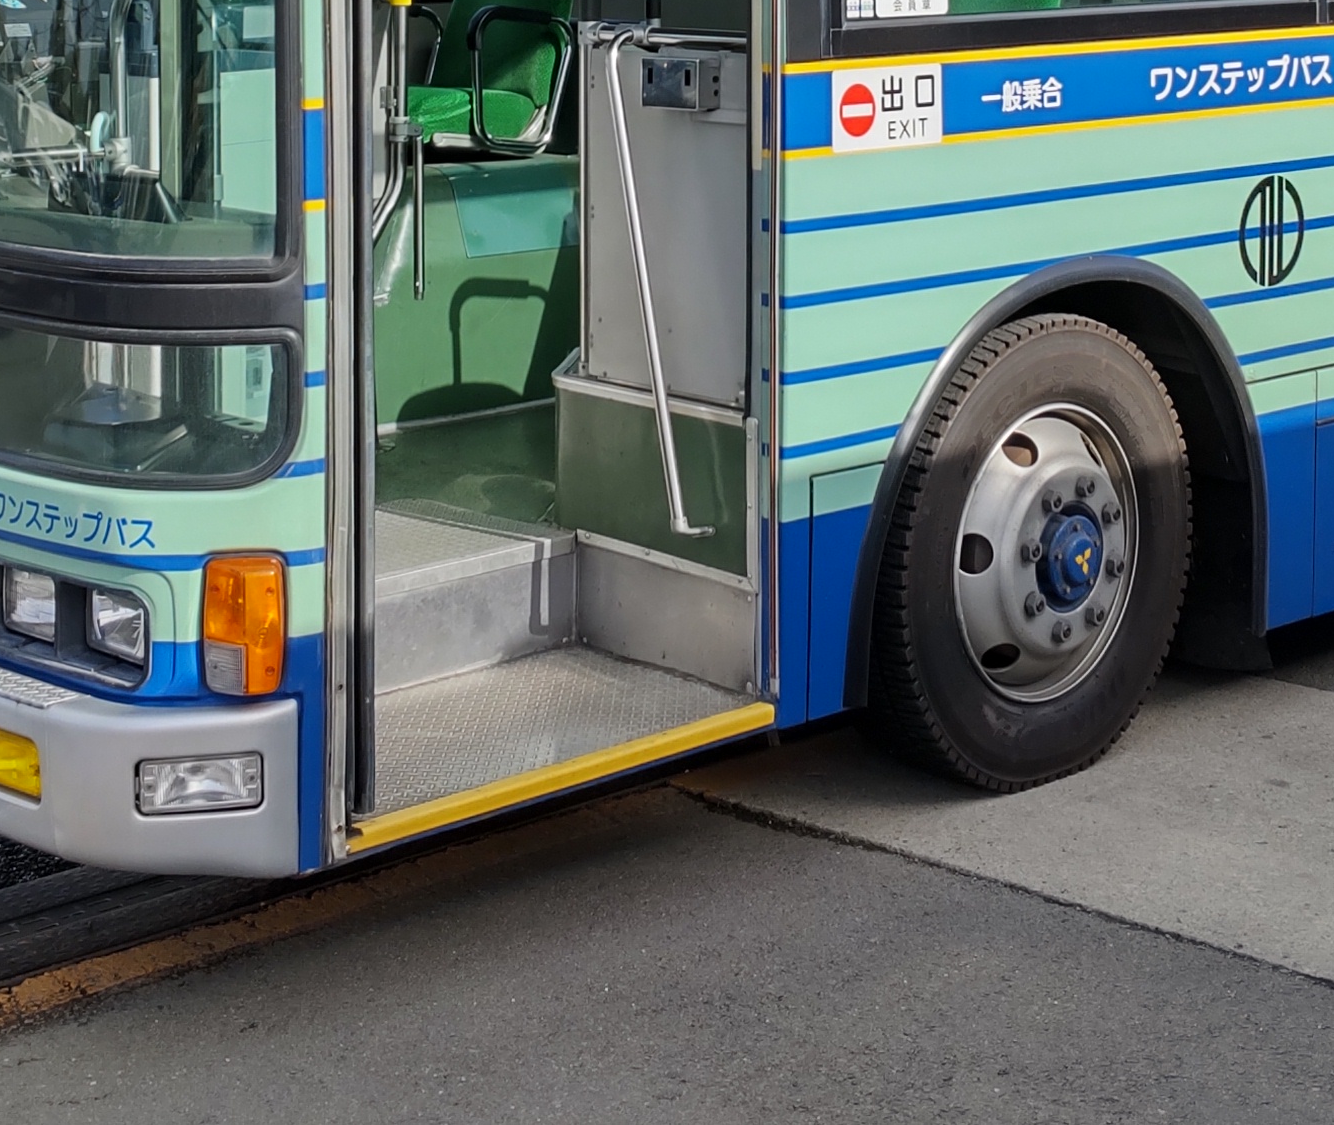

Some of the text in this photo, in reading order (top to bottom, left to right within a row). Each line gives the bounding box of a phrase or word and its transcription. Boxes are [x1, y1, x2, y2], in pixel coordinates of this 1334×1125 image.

[881, 74, 935, 112] 出口
[980, 76, 1064, 113] 一般乗合
[1149, 53, 1333, 102] ワンステップバス
[888, 117, 928, 140] EXIT
